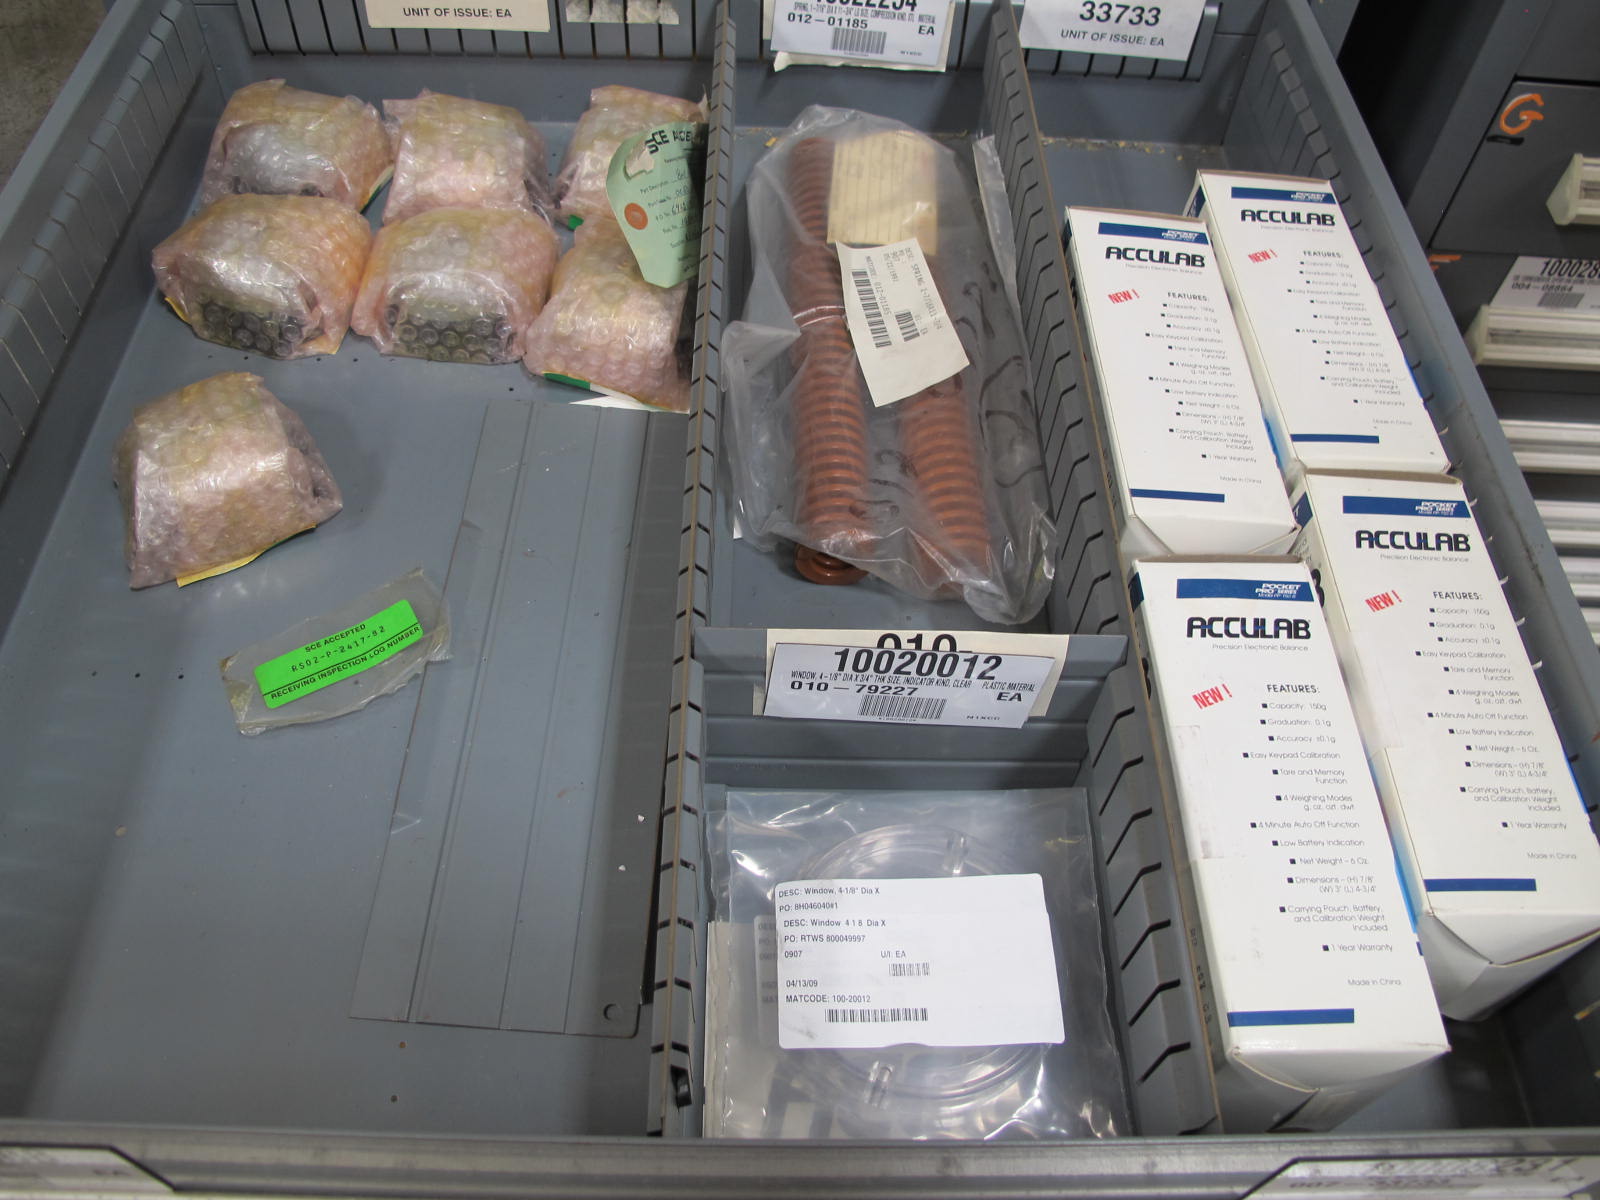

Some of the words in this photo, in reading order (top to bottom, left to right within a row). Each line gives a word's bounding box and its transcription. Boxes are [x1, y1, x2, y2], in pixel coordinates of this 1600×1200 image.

[403, 7, 430, 17] UNIT
[434, 8, 450, 17] OF
[453, 8, 493, 18] ISSUE:
[496, 9, 512, 18] EA
[1080, 0, 1161, 26] 33733
[918, 24, 935, 36] EA
[1061, 28, 1088, 40] UNIT
[1091, 32, 1106, 41] OF
[1109, 33, 1146, 45] ISSUE:
[1149, 37, 1165, 46] EA
[1500, 93, 1544, 135] G
[1241, 209, 1336, 226] ACCULAB
[1105, 246, 1205, 267] ACCULAB
[1248, 250, 1271, 264] NEW
[1539, 258, 1600, 279] 100028
[1108, 290, 1133, 304] NEW
[1356, 530, 1471, 551] ACCULAB
[1433, 591, 1483, 600] FEATURES:
[1365, 592, 1395, 613] NEW
[1186, 617, 1311, 640] ACCULAB
[305, 642, 322, 653] SCE
[324, 624, 366, 646] ACCEPTED
[271, 677, 316, 700] RECEIVING
[318, 656, 368, 680] INSPECTION
[369, 646, 386, 659] LOG
[387, 626, 420, 649] NUMBER
[834, 648, 1003, 680] 10020012
[791, 671, 816, 680] WINDOW,
[903, 677, 934, 686] INDICATOR
[953, 680, 972, 688] CLEAR
[982, 682, 1005, 690] PLASTIC
[1007, 682, 1036, 692] MATERIAL
[1267, 684, 1320, 693] FEATURES:
[996, 692, 1022, 701] EA
[1192, 686, 1226, 710] NEW
[1222, 683, 1233, 698] !
[1309, 702, 1327, 711] 150g
[1268, 718, 1312, 726] Graduation:
[1314, 719, 1331, 727] 0.1g
[1250, 751, 1267, 760] Easy
[1269, 751, 1301, 760] Keypad
[1302, 751, 1341, 760] Calibration
[1280, 768, 1296, 776] Tare
[1297, 768, 1314, 776] and
[1314, 768, 1345, 777] Memory
[1289, 795, 1325, 803] Weighing
[1265, 821, 1292, 829] Minute
[1294, 821, 1313, 829] Auto
[1314, 821, 1326, 829] Off
[1327, 821, 1360, 829] Function
[1298, 839, 1325, 847] Battery
[1315, 857, 1343, 866] Weight
[1295, 876, 1339, 884] Dimensions
[1347, 876, 1359, 884] (H)
[779, 889, 802, 898] DESC:
[1320, 885, 1334, 893] (W)
[780, 904, 792, 912] PO:
[1288, 905, 1322, 913] Carrying
[1294, 915, 1311, 923] and
[1312, 914, 1356, 922] Calibration
[1357, 914, 1385, 924] Weight
[784, 935, 798, 943] PO:
[801, 934, 824, 942] RTWS
[1357, 944, 1393, 952] Warranty
[785, 950, 802, 958] 0907
[786, 980, 818, 988] 04/13/09
[786, 995, 830, 1003] MATCODE:
[832, 995, 871, 1003] 100-20012
